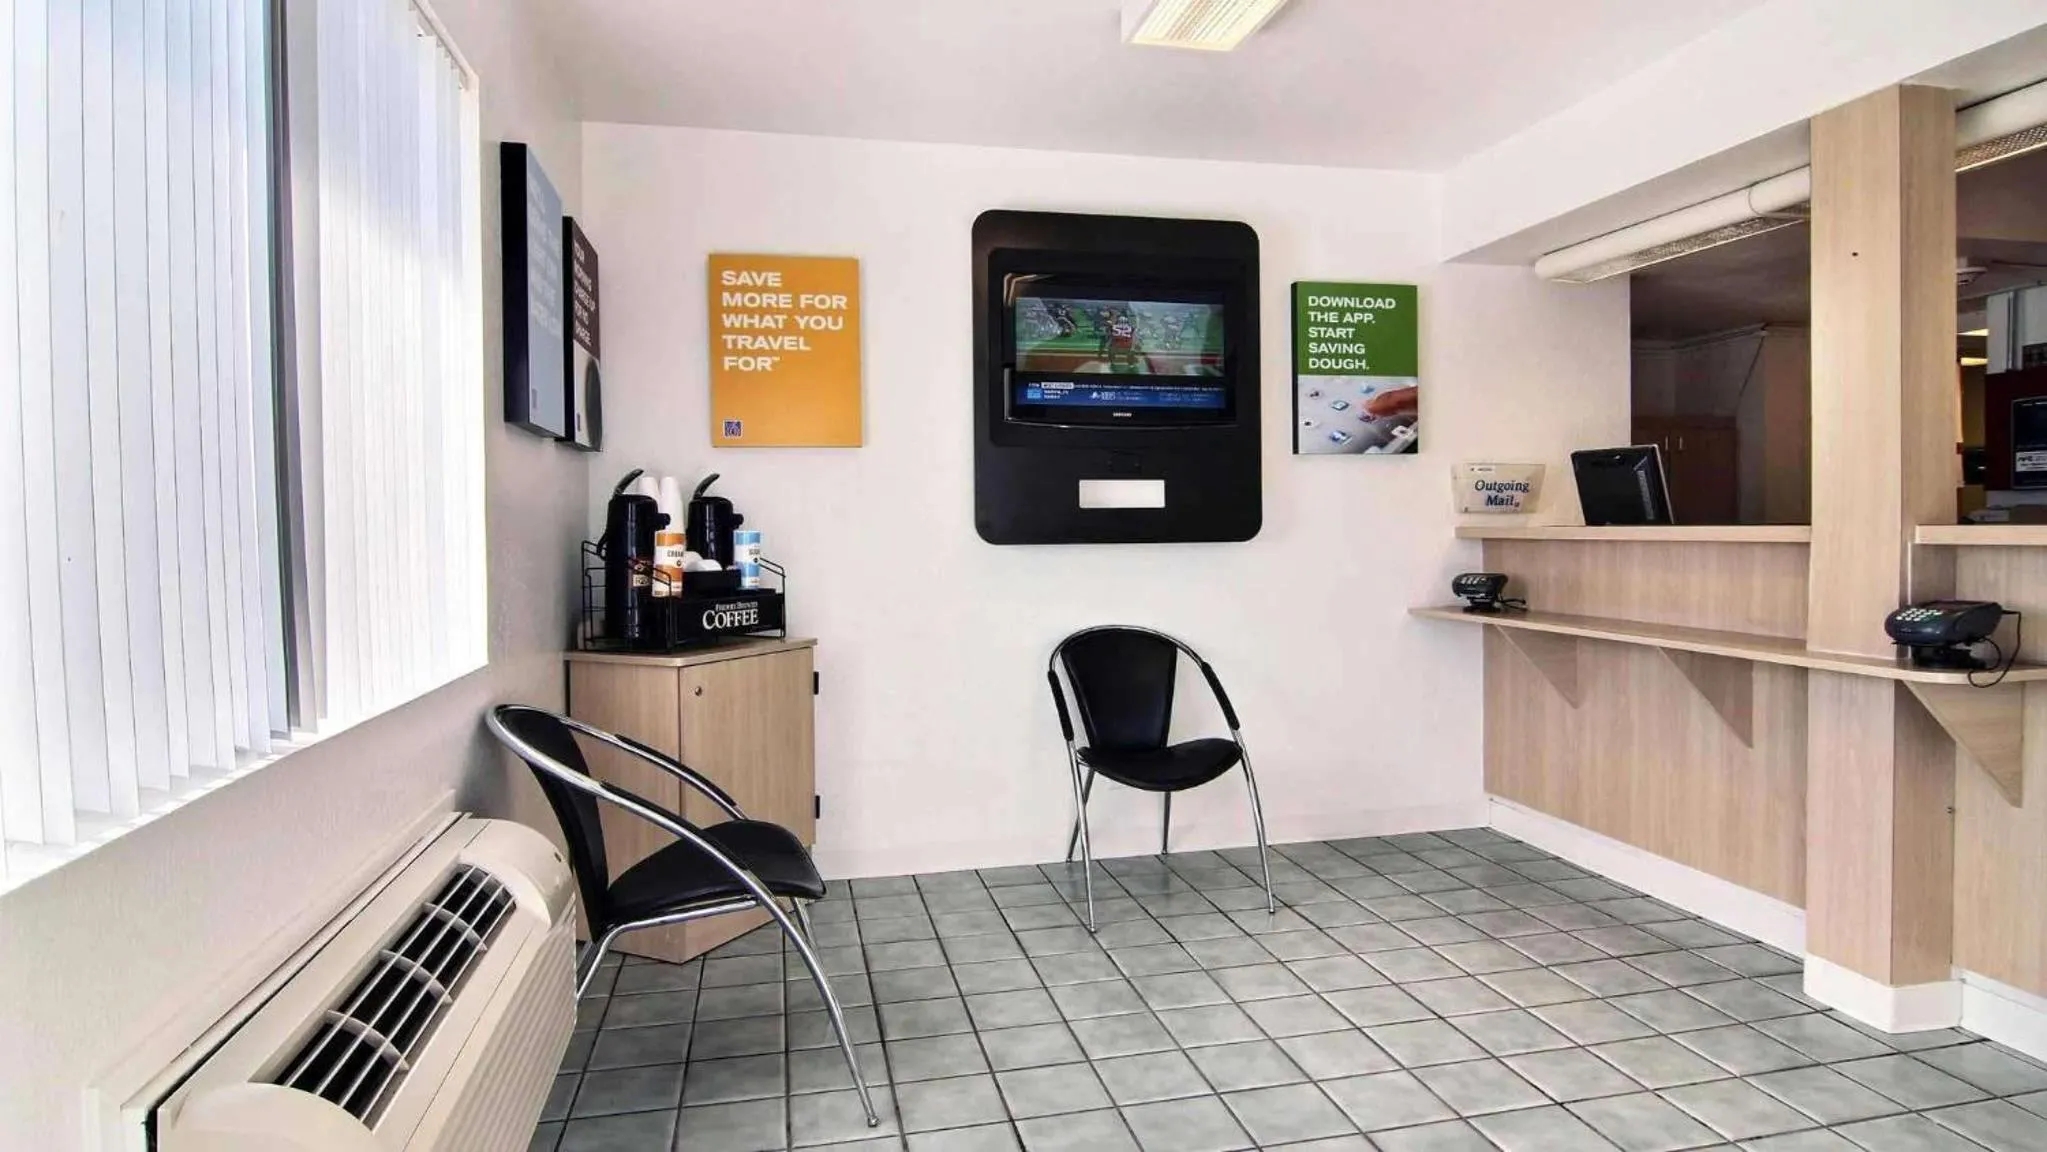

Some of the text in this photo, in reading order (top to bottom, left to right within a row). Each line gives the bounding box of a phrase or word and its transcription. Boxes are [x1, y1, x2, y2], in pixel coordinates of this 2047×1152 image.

[722, 270, 782, 287] SAVE
[722, 292, 848, 310] MORE FOR
[1308, 296, 1396, 309] DOWNLOAD
[722, 313, 844, 330] WHAT YOU
[1308, 311, 1376, 324] THE APP.
[1308, 327, 1355, 339] START
[722, 335, 811, 351] TRAVEL
[1308, 342, 1366, 354] SAVING
[1308, 358, 1370, 370] DOUGH.
[1474, 479, 1529, 493] Outgoing
[1485, 494, 1514, 506] Mail
[702, 609, 759, 629] COFFEE
